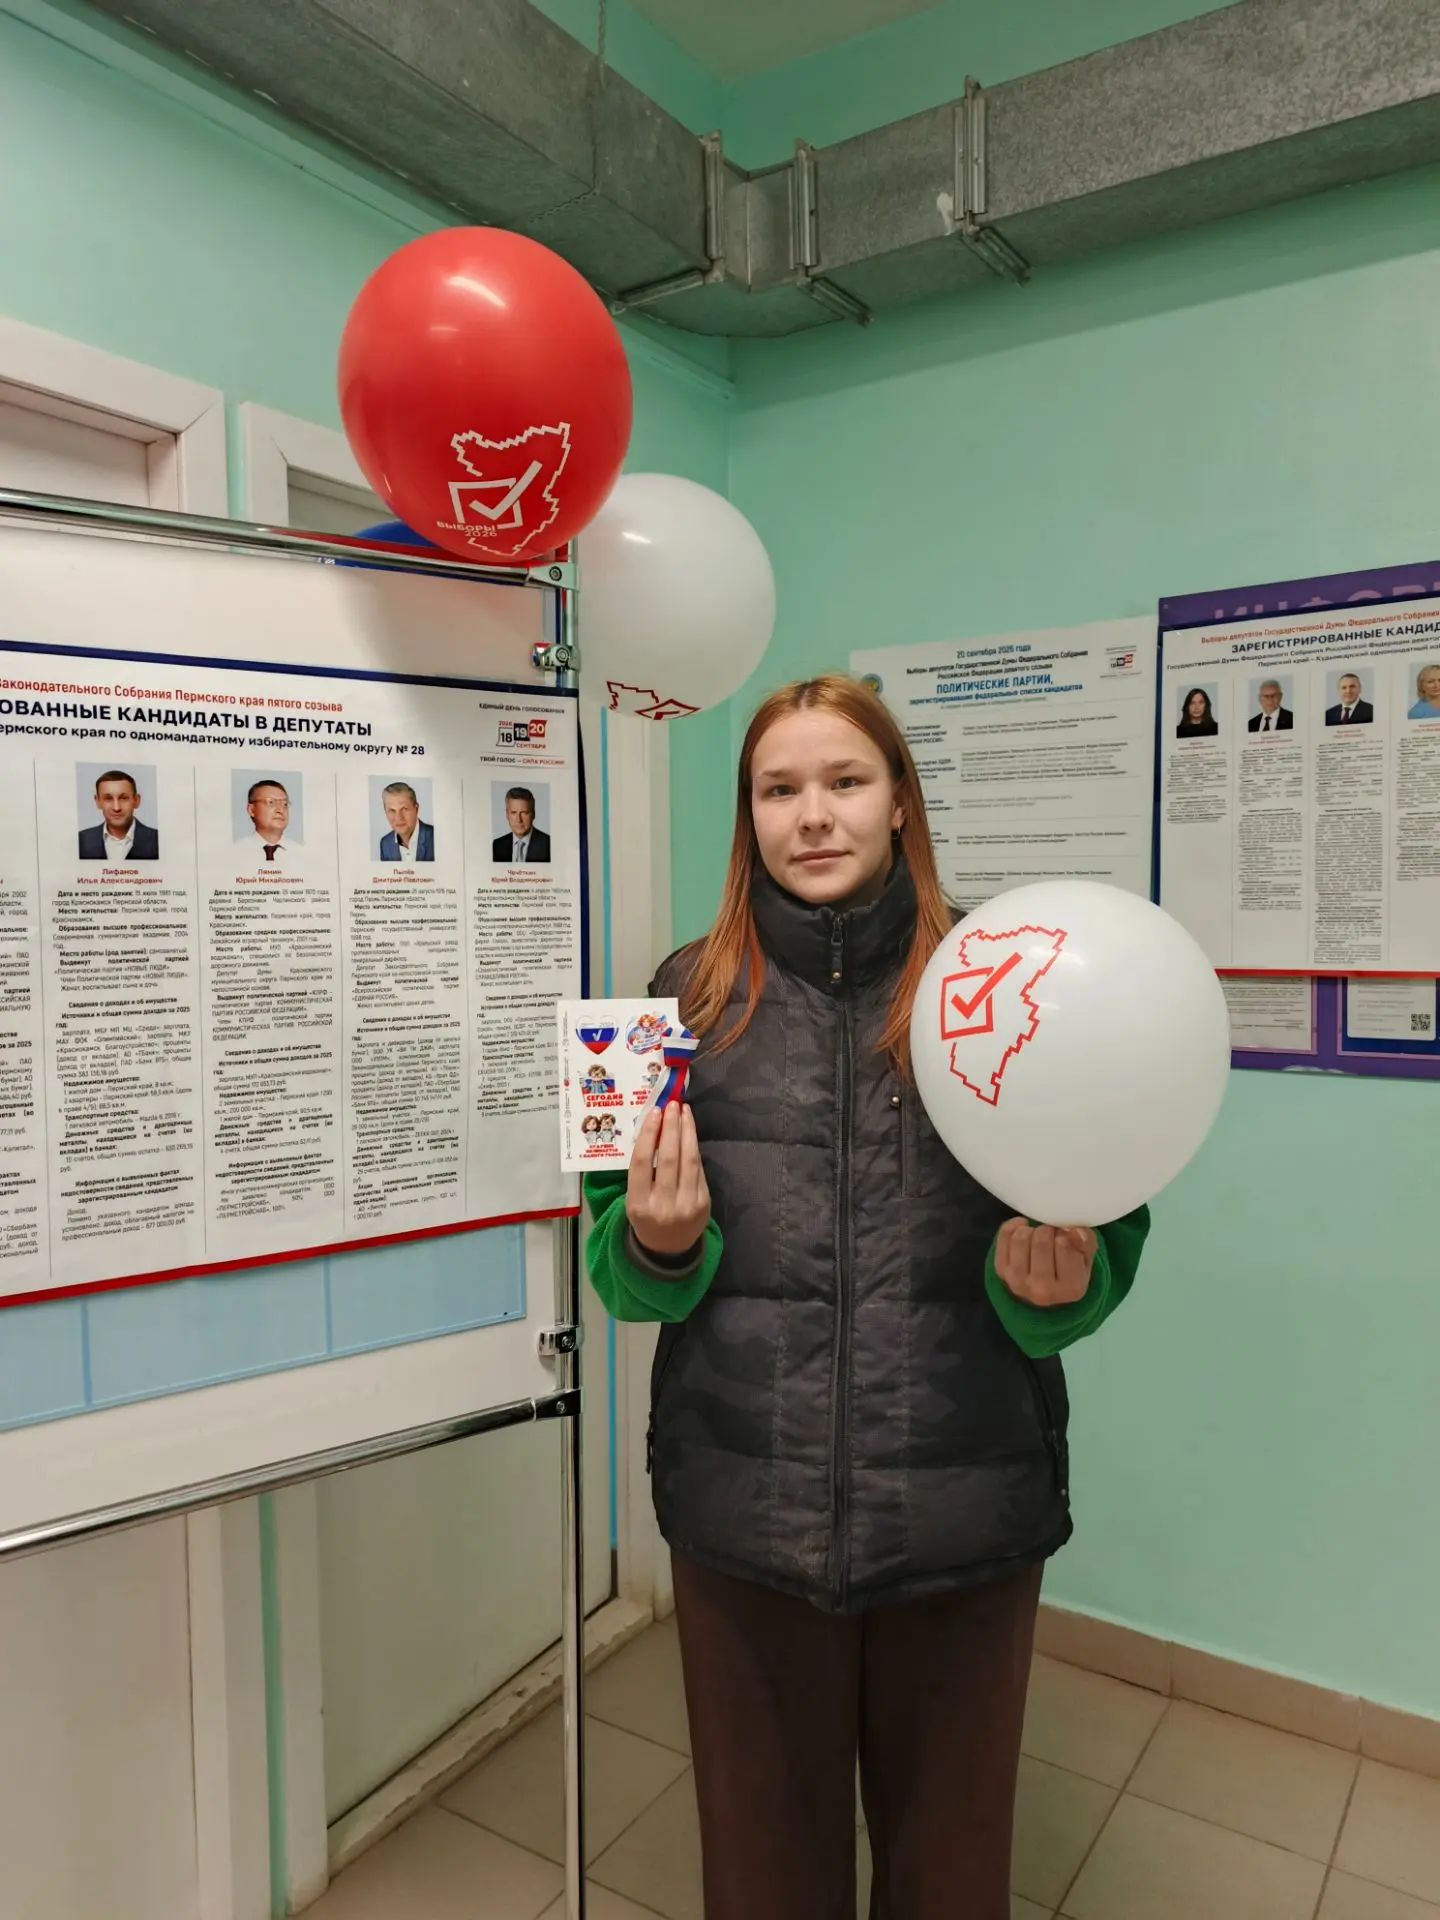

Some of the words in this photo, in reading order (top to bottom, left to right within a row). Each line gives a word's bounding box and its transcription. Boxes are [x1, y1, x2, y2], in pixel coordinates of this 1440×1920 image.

[436, 520, 496, 532] ВЫБОРЫ
[1231, 629, 1382, 654] ЗАРЕГИСТРИРОВАННЫЕ
[956, 650, 965, 659] 20
[936, 677, 1010, 695] ПОЛИТИЧЕСКИЕ
[1012, 673, 1053, 687] ПАРТИИ,
[114, 684, 172, 700] Собрания
[175, 689, 236, 704] Пермского
[239, 696, 265, 707] края
[267, 698, 302, 710] пятого
[304, 701, 343, 713] созыва
[117, 706, 250, 729] КАНДИДАТЫ
[255, 715, 268, 730] В
[272, 716, 372, 737] ДЕПУТАТЫ
[500, 732, 513, 743] 18
[514, 727, 528, 738] 19
[529, 723, 545, 734] 20
[71, 728, 106, 740] края
[109, 729, 127, 740] по
[129, 730, 245, 748] одномандатному
[248, 736, 350, 753] избирательному
[353, 743, 393, 756] округу
[395, 744, 408, 754] №
[410, 745, 425, 755] 28
[102, 868, 139, 876] Лифанов
[99, 877, 163, 885] Александрович
[16, 1040, 33, 1048] 2025
[586, 1093, 623, 1101] СЕГОДНЯ
